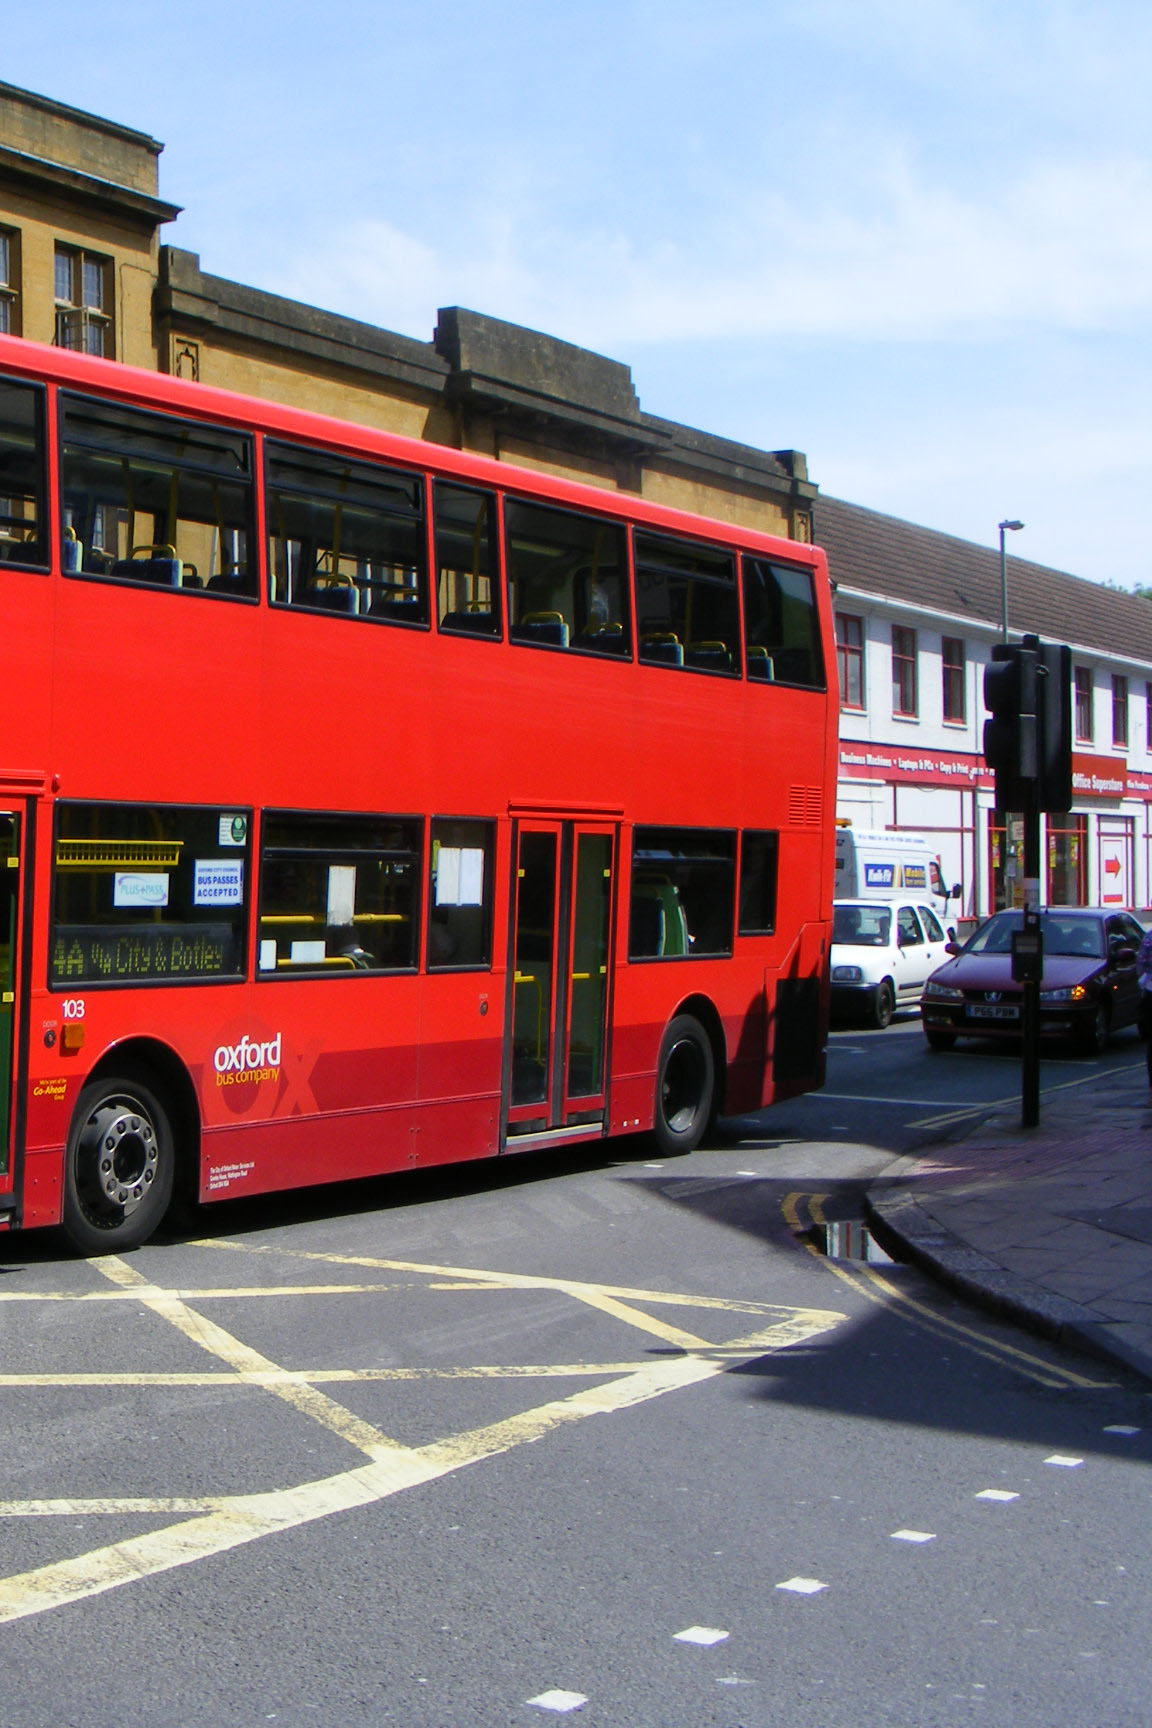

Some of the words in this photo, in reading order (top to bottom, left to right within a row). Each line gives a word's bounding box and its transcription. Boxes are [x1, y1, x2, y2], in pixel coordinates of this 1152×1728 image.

[1072, 773, 1091, 789] Office
[1092, 775, 1123, 793] Superstore
[198, 876, 212, 885] BUS
[213, 876, 238, 885] PASSES
[198, 888, 238, 897] ACCEPTED
[116, 937, 150, 973] City
[62, 999, 85, 1018] 103
[214, 1032, 282, 1073] oxford
[216, 1071, 234, 1086] bus
[235, 1068, 280, 1085] company
[33, 1084, 67, 1096] Go-Ahead
